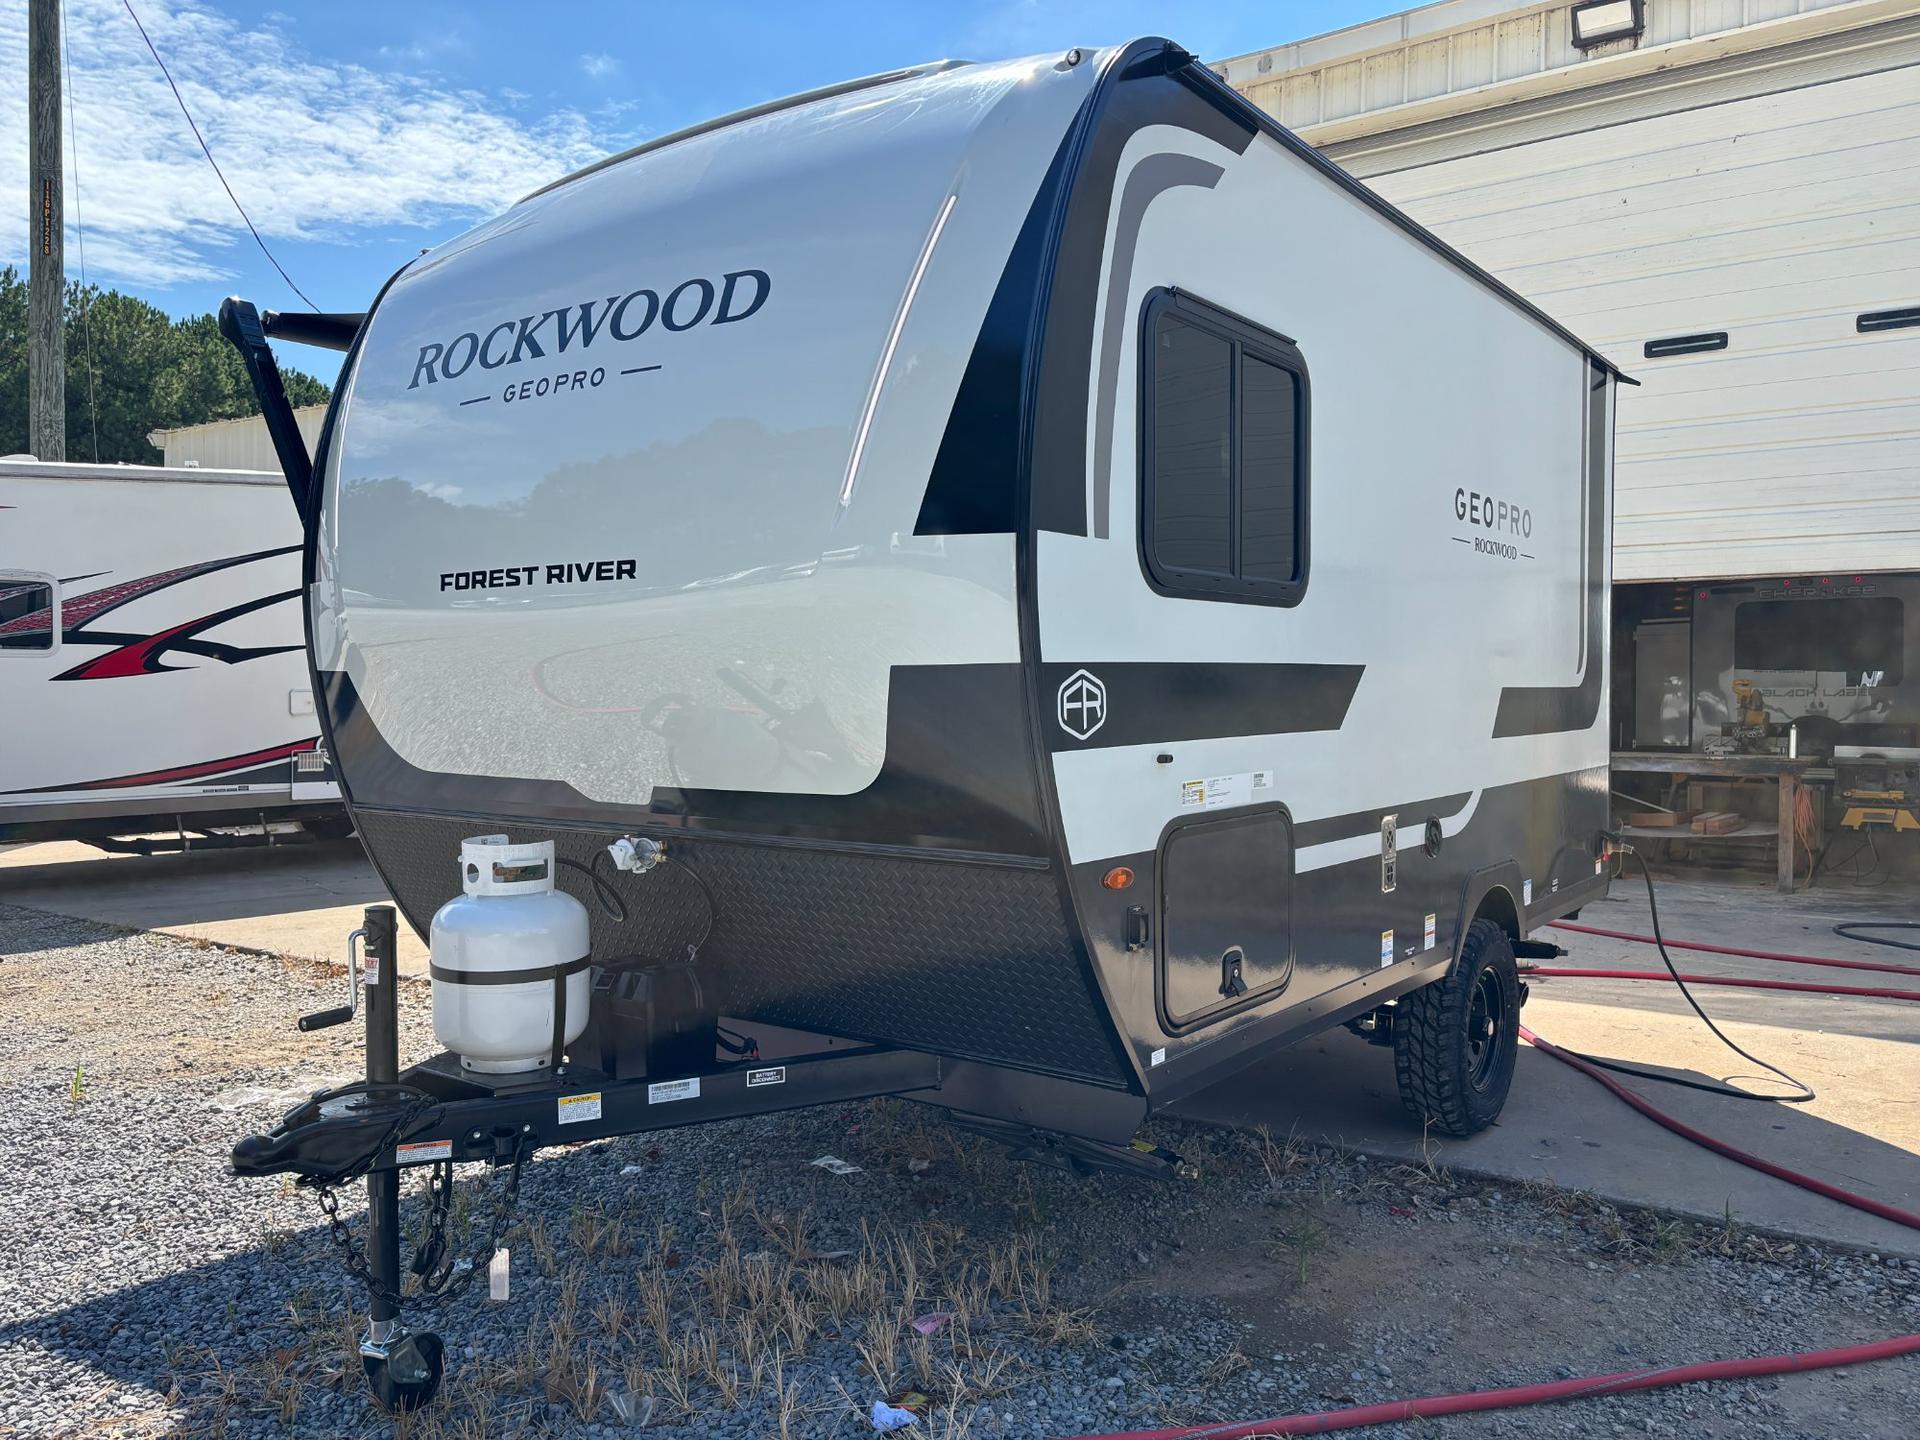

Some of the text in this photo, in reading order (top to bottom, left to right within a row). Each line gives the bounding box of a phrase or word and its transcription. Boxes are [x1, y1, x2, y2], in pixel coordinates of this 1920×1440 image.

[407, 269, 771, 390] ROCKWOOD
[503, 367, 606, 403] GEOPRO
[1455, 487, 1531, 538] GEOPRO
[1474, 537, 1517, 560] ROCKWOOD
[440, 559, 637, 592] FOREST RIVER
[1759, 585, 1877, 600] CHERKEE
